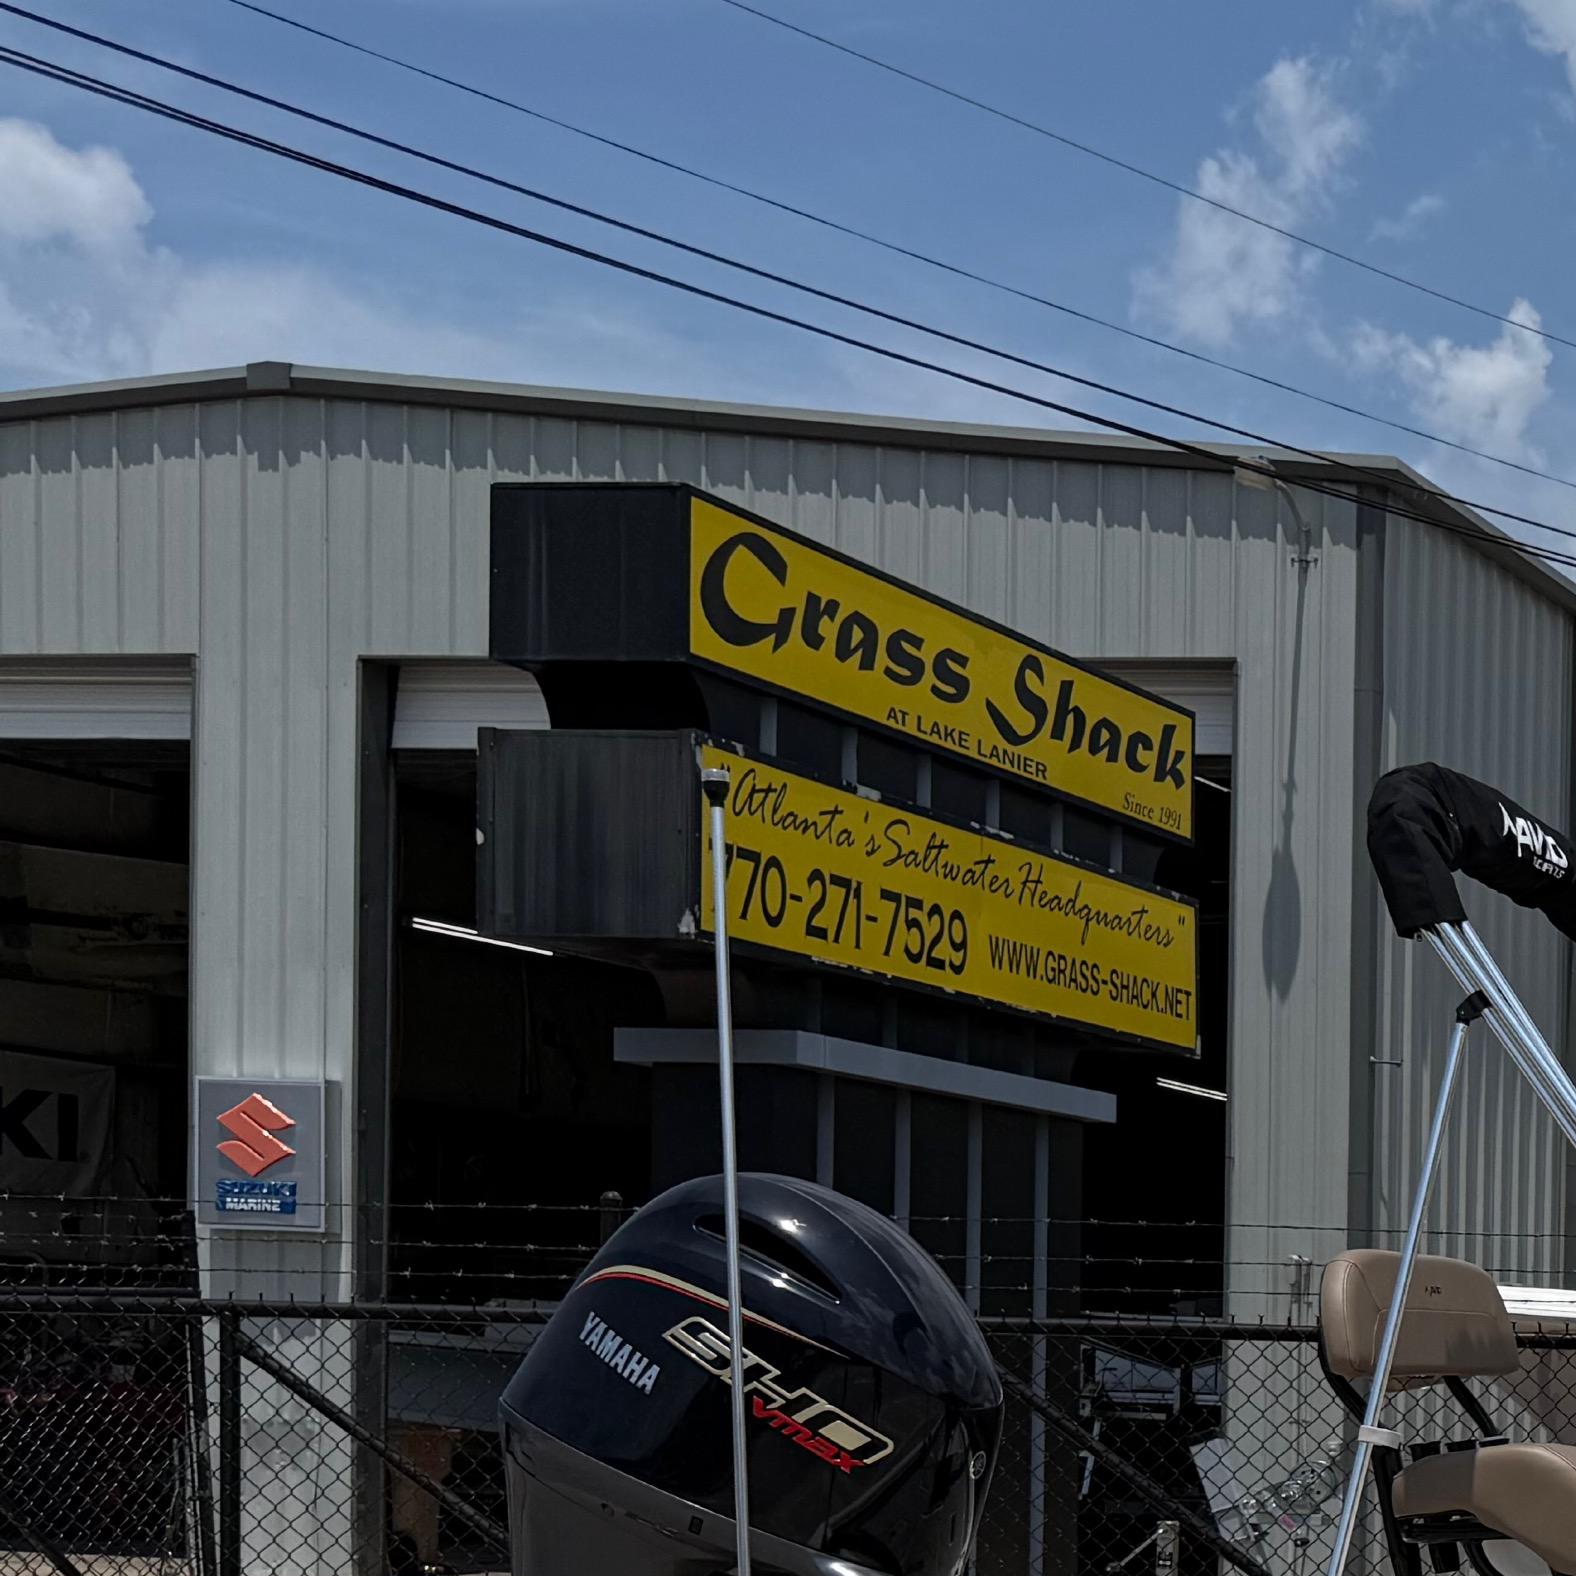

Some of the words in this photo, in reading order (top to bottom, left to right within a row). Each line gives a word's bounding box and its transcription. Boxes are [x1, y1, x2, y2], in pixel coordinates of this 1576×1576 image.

[700, 532, 971, 703] Grass
[985, 654, 1186, 790] Shack
[886, 706, 910, 728] AT
[916, 715, 971, 750] LAKE
[977, 739, 1048, 781] LANIER
[1122, 791, 1155, 821] Since
[1159, 804, 1183, 831] 1991
[883, 819, 1015, 899] Saltwater
[988, 933, 1193, 1021] WWW.GRASS-SHACK.NET
[226, 1197, 281, 1212] MARINE
[577, 1311, 661, 1396] YAMAHA
